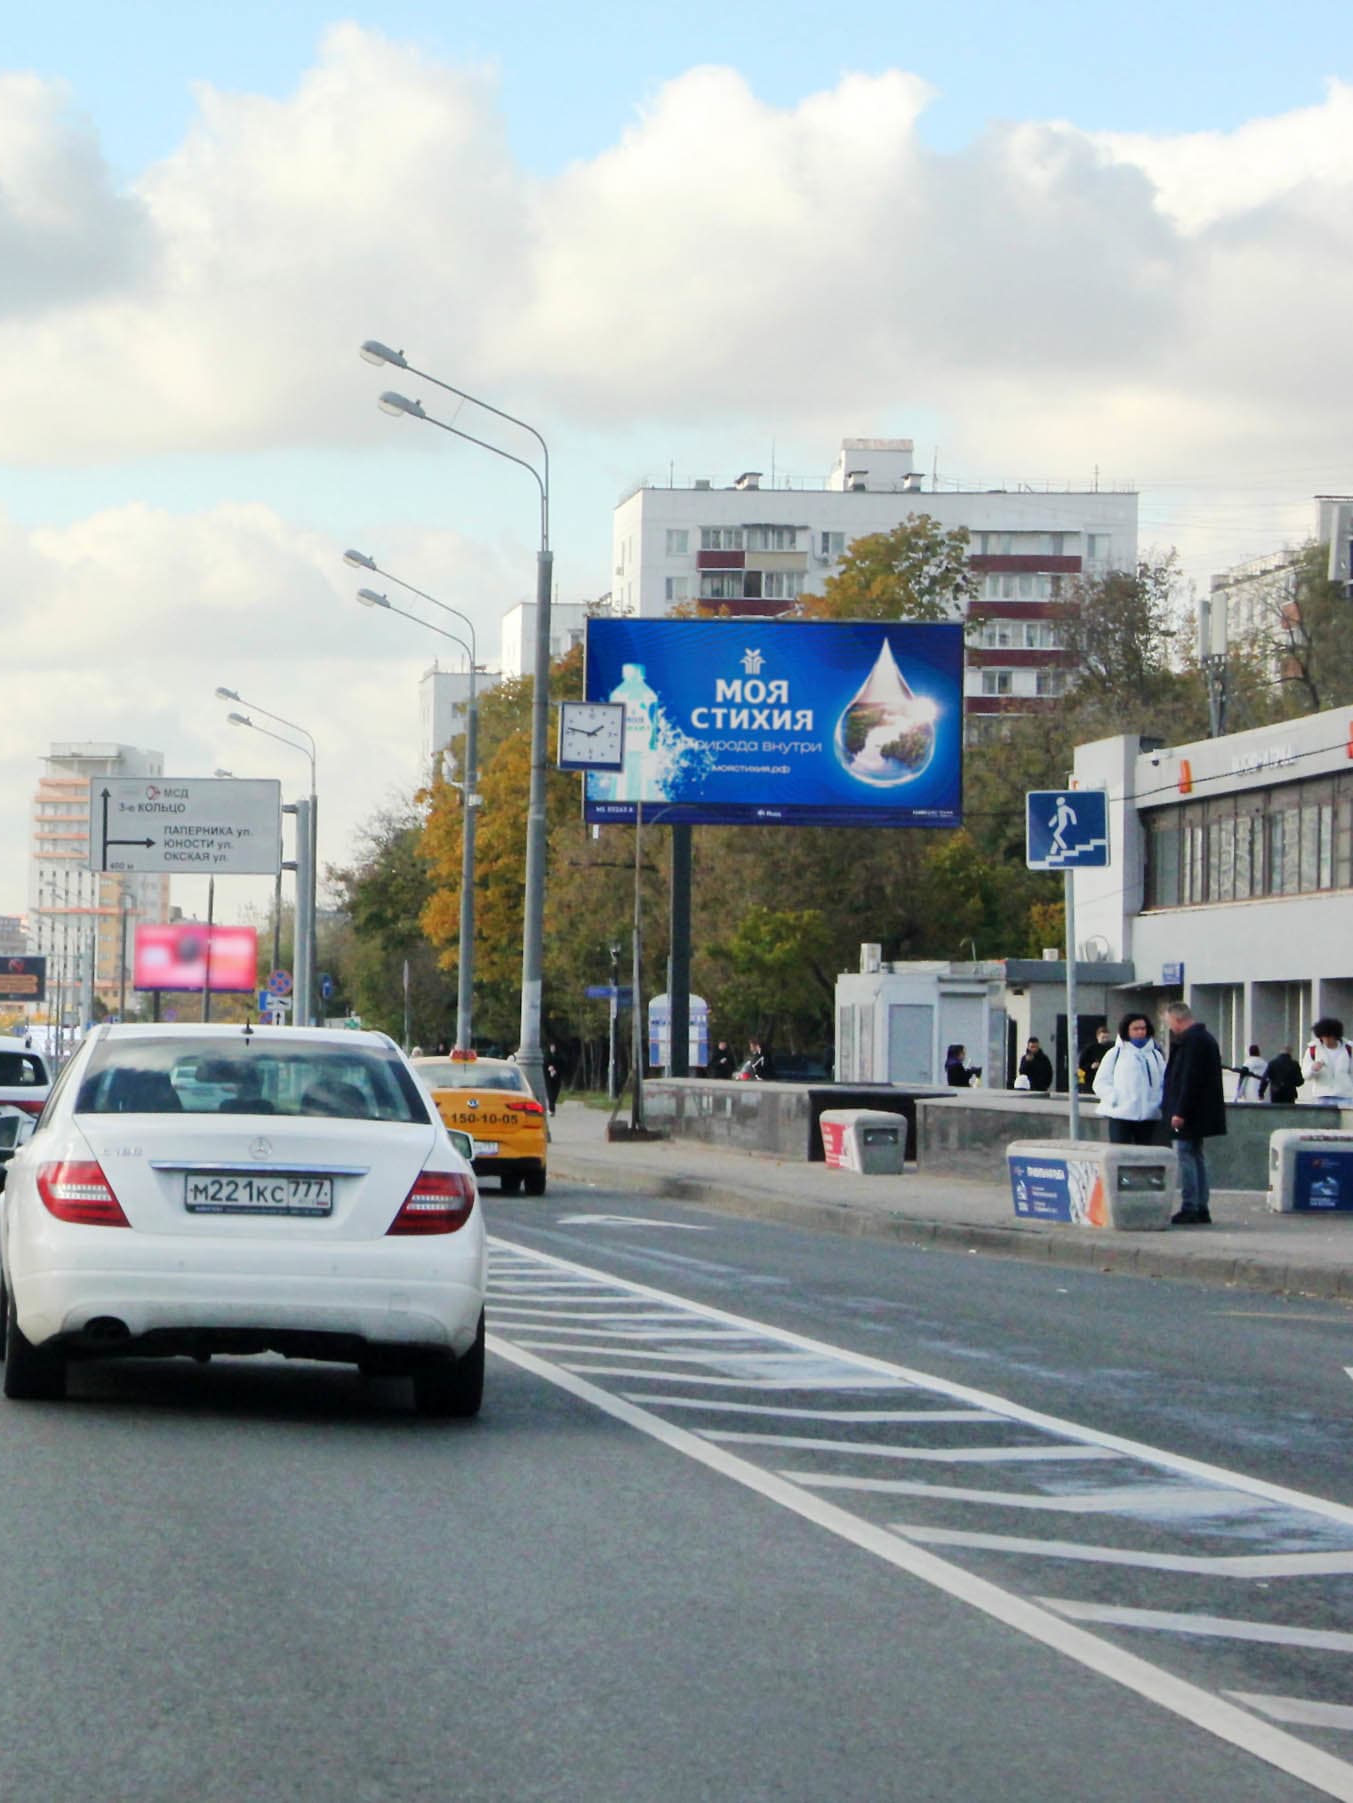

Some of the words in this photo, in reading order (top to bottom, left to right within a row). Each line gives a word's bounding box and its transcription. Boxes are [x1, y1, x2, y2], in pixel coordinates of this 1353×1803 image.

[715, 679, 789, 704] МОЯ
[691, 707, 814, 731] СТИХИЯ
[762, 740, 823, 755] внутри
[137, 803, 186, 813] КОЛЬЦО
[164, 825, 234, 836] ПАПЕРНИКА
[164, 838, 215, 848] ЮНОСТИ
[164, 851, 210, 862] ОКСКАЯ
[452, 1112, 519, 1124] 150-10-05
